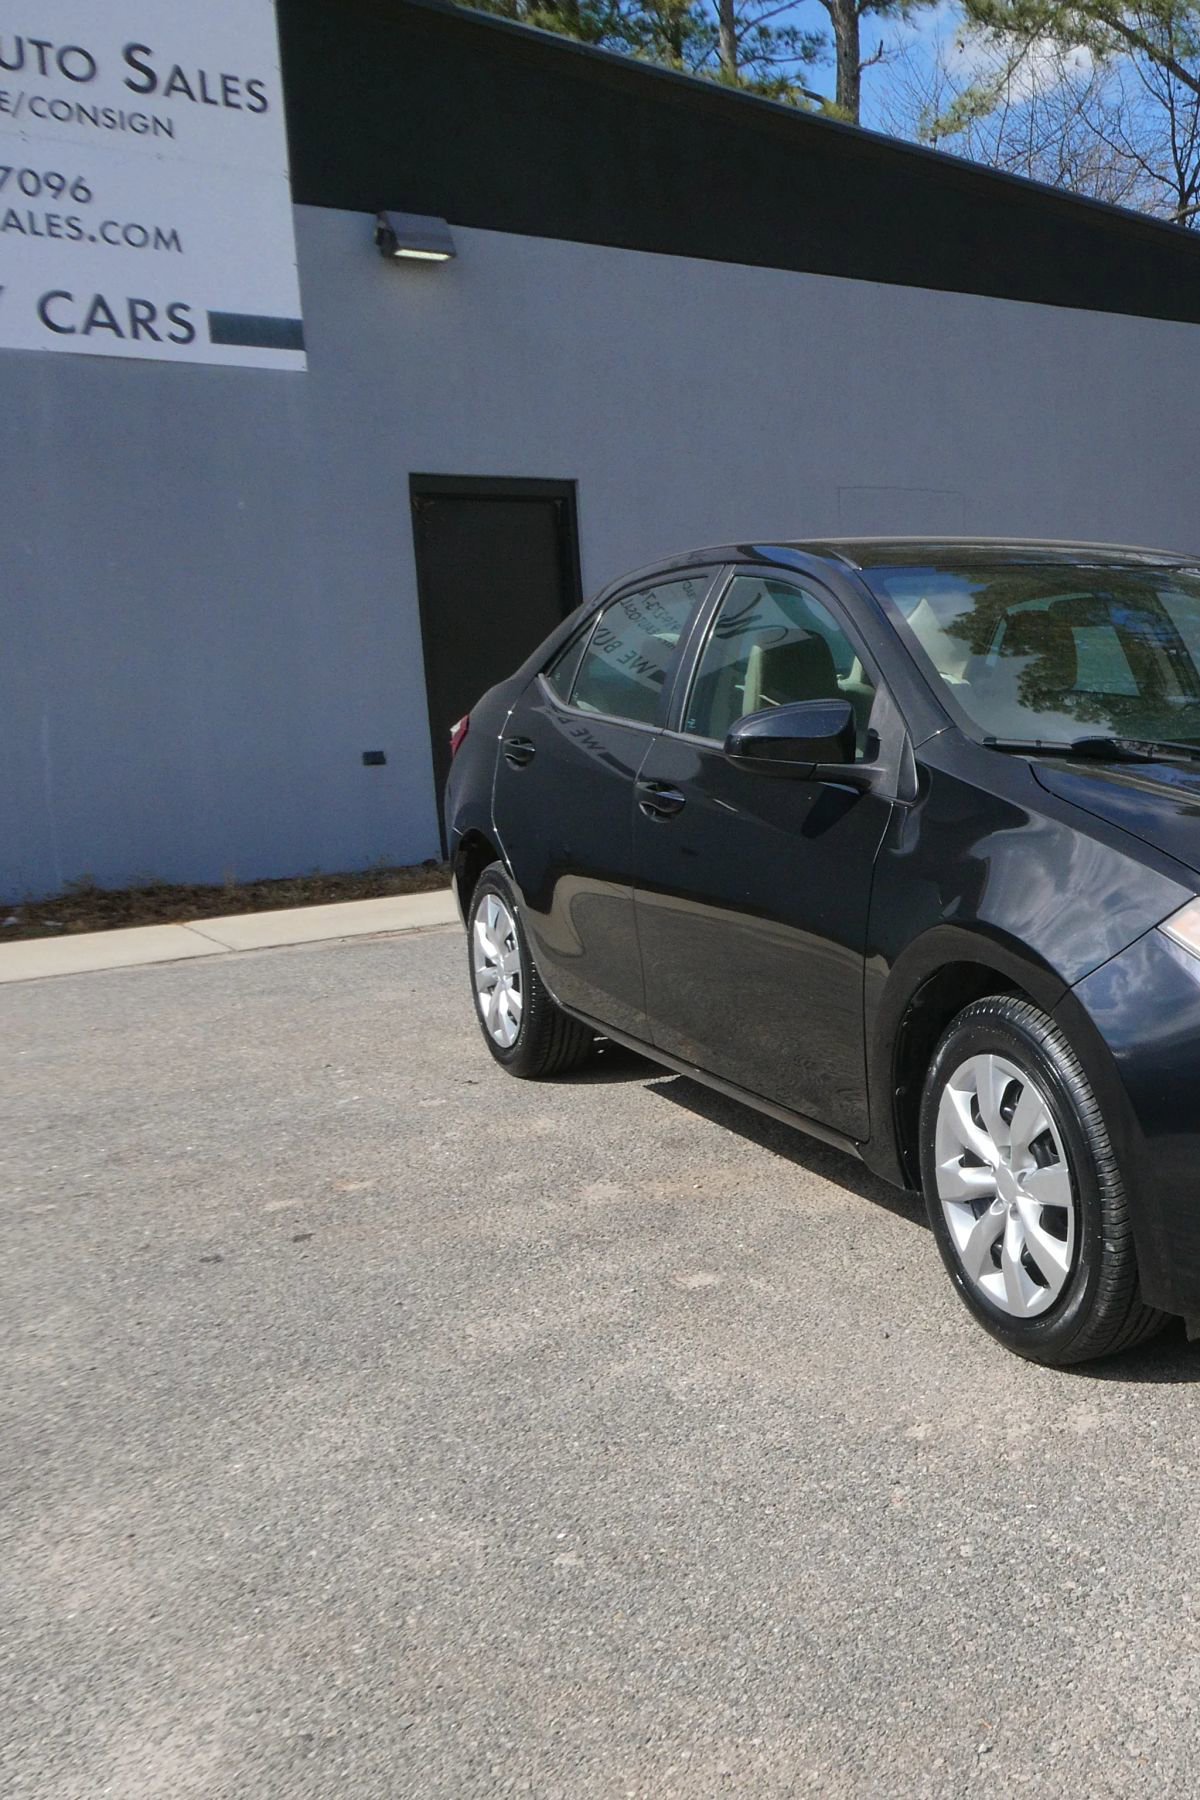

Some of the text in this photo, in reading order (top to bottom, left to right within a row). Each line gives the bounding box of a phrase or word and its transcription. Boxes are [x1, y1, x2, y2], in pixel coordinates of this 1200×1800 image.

[121, 42, 269, 114] SALES
[0, 207, 183, 253] ALES.COM
[37, 289, 196, 345] CARS
